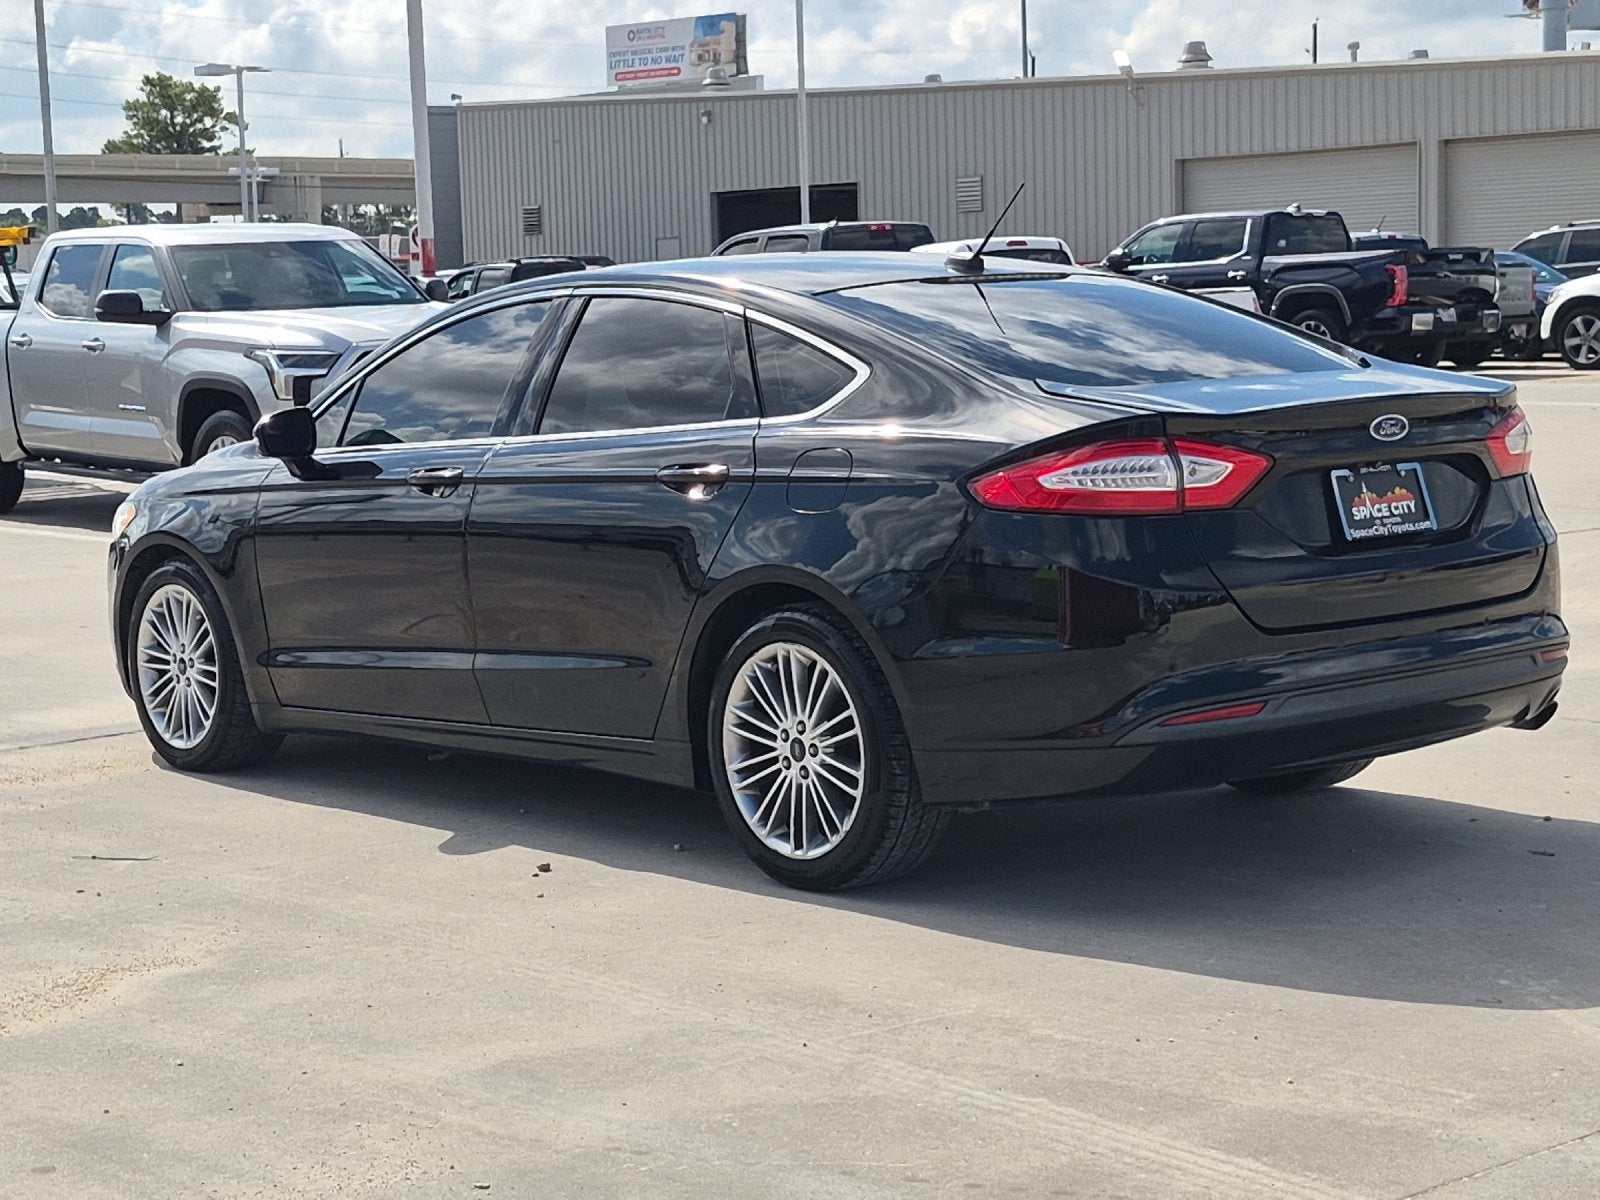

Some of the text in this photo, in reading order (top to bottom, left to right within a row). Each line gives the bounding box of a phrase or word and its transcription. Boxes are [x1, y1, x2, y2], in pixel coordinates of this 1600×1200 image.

[610, 53, 685, 70] LITTLE TO NO WAIT
[1352, 500, 1415, 520] SPACE CITY
[1351, 521, 1432, 539] SpaceCityToyota.com
